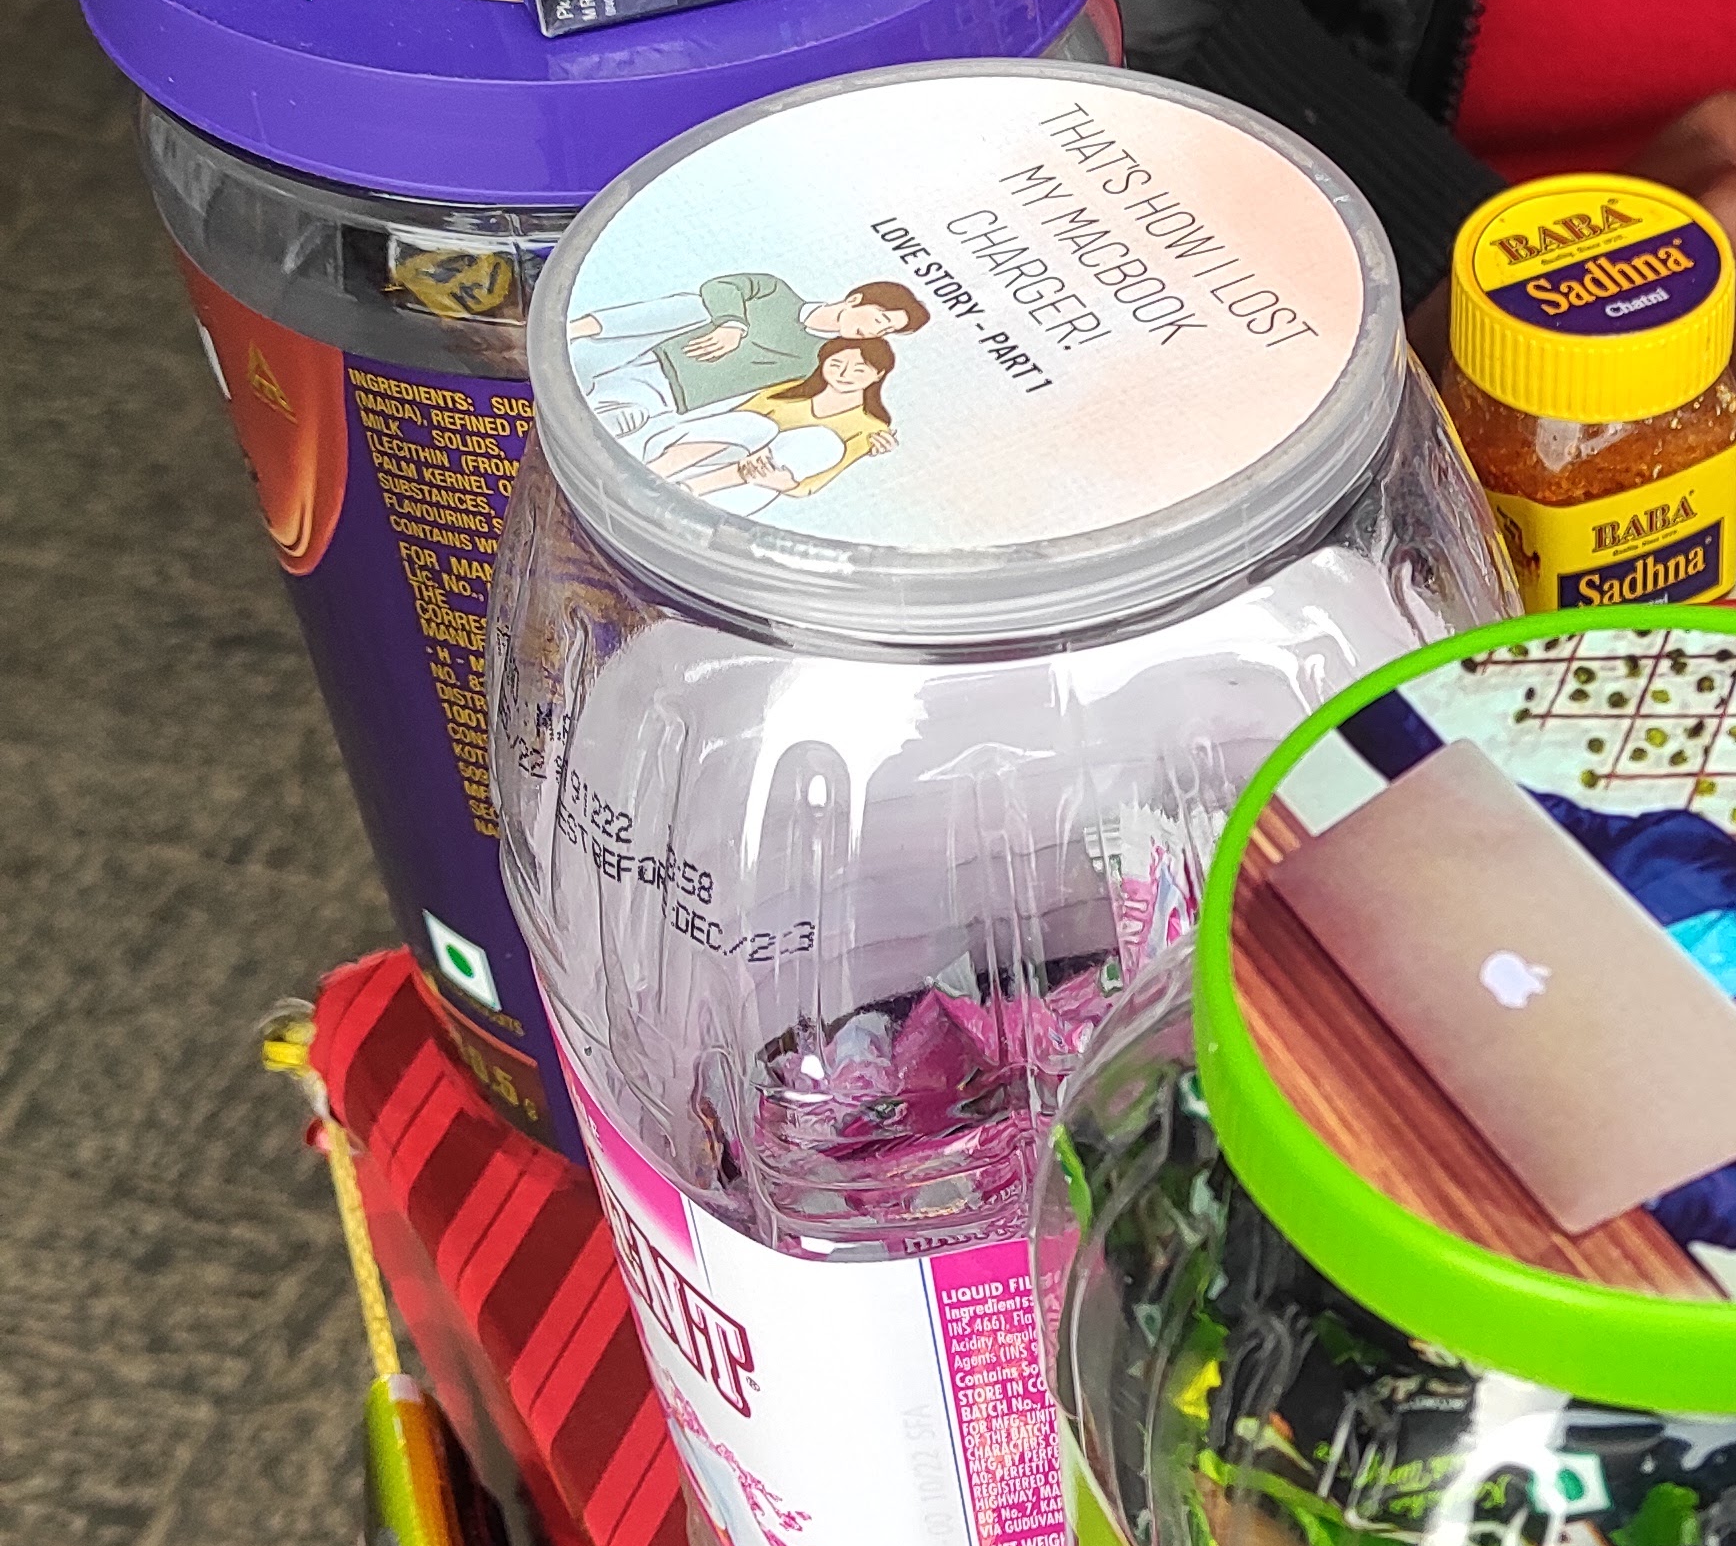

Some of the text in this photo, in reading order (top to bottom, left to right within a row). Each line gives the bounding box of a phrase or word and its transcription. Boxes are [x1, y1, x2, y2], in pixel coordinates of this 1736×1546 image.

[1039, 102, 1319, 348] THAT'S HOW I LOST
[1490, 205, 1642, 266] BABA
[1001, 165, 1209, 346] MY MACBOOK
[945, 210, 1110, 352] CHARGER!
[1526, 244, 1695, 317] Sadhna
[871, 216, 931, 269] LOVE
[914, 260, 985, 319] STORY
[978, 329, 1044, 380] PART
[1025, 377, 1053, 394] 1
[1605, 287, 1669, 318] Chatni
[348, 368, 475, 412] INGREDIENTS:
[361, 411, 505, 458] MILK SOLIDS,
[431, 409, 510, 436] REFINED
[372, 453, 494, 494] PALM KERNEL
[378, 473, 495, 516] SUBSTANCES,
[384, 493, 488, 533] FLAVOURING
[1591, 493, 1697, 553] BABA
[390, 515, 472, 551] CONTAINS
[398, 541, 439, 570] FOR
[1577, 543, 1706, 609] Sadhna
[409, 580, 449, 608] THE
[941, 1282, 1004, 1304] LIQUID
[945, 1296, 1034, 1321] Ingredients:
[948, 1319, 970, 1337] INS
[951, 1335, 993, 1353] Acidity
[954, 1351, 996, 1370] Agents
[955, 1365, 1019, 1388] Contains
[958, 1381, 1023, 1406] STORE IN
[961, 1402, 1008, 1422] BATCH
[962, 1408, 1056, 1436] FOR UNIT
[967, 1437, 1046, 1460] CHARACTERS
[996, 1461, 1049, 1479] PERFETTI
[973, 1474, 1045, 1498] REGISTERED
[975, 1488, 1037, 1511] HIGHWAY,
[980, 1523, 1002, 1537] VIA
